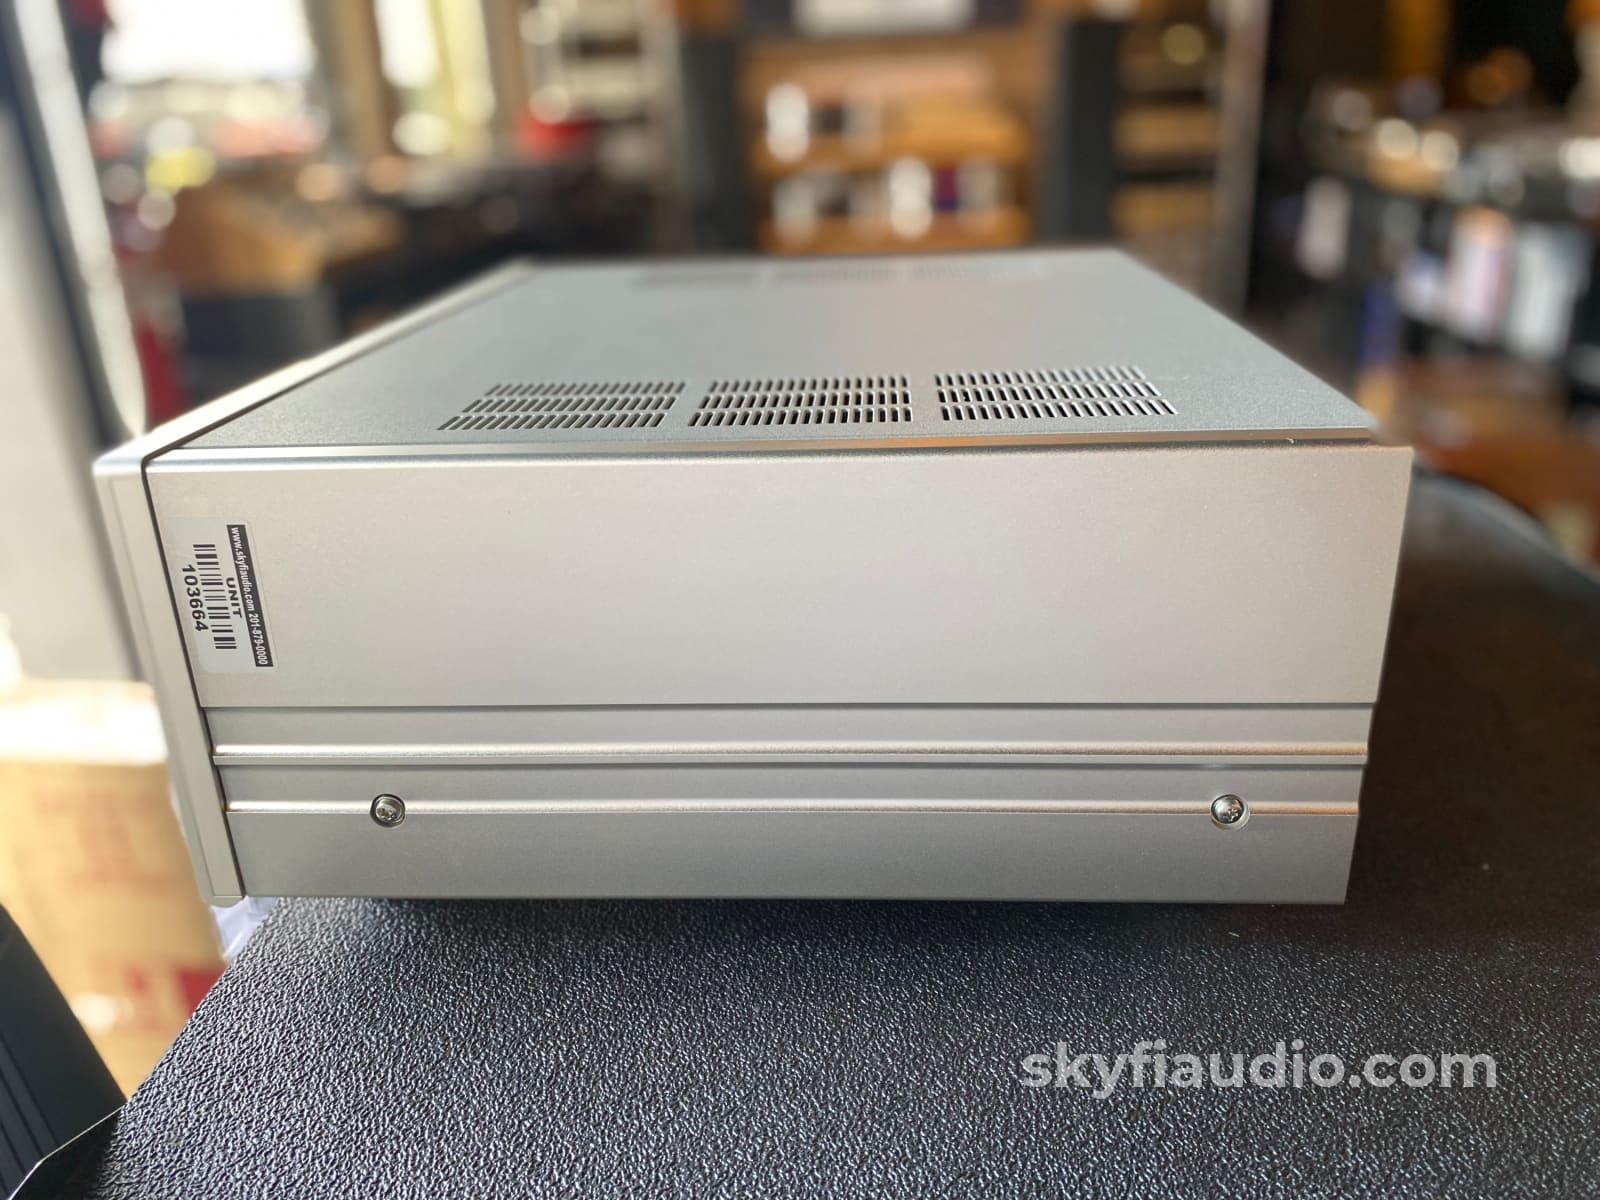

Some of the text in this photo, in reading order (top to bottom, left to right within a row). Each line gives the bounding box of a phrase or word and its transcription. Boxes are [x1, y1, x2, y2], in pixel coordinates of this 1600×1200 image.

[182, 564, 209, 631] 103664
[226, 577, 242, 618] UNIT
[231, 527, 269, 665] www.skyfiaudio.com 201-879-0000
